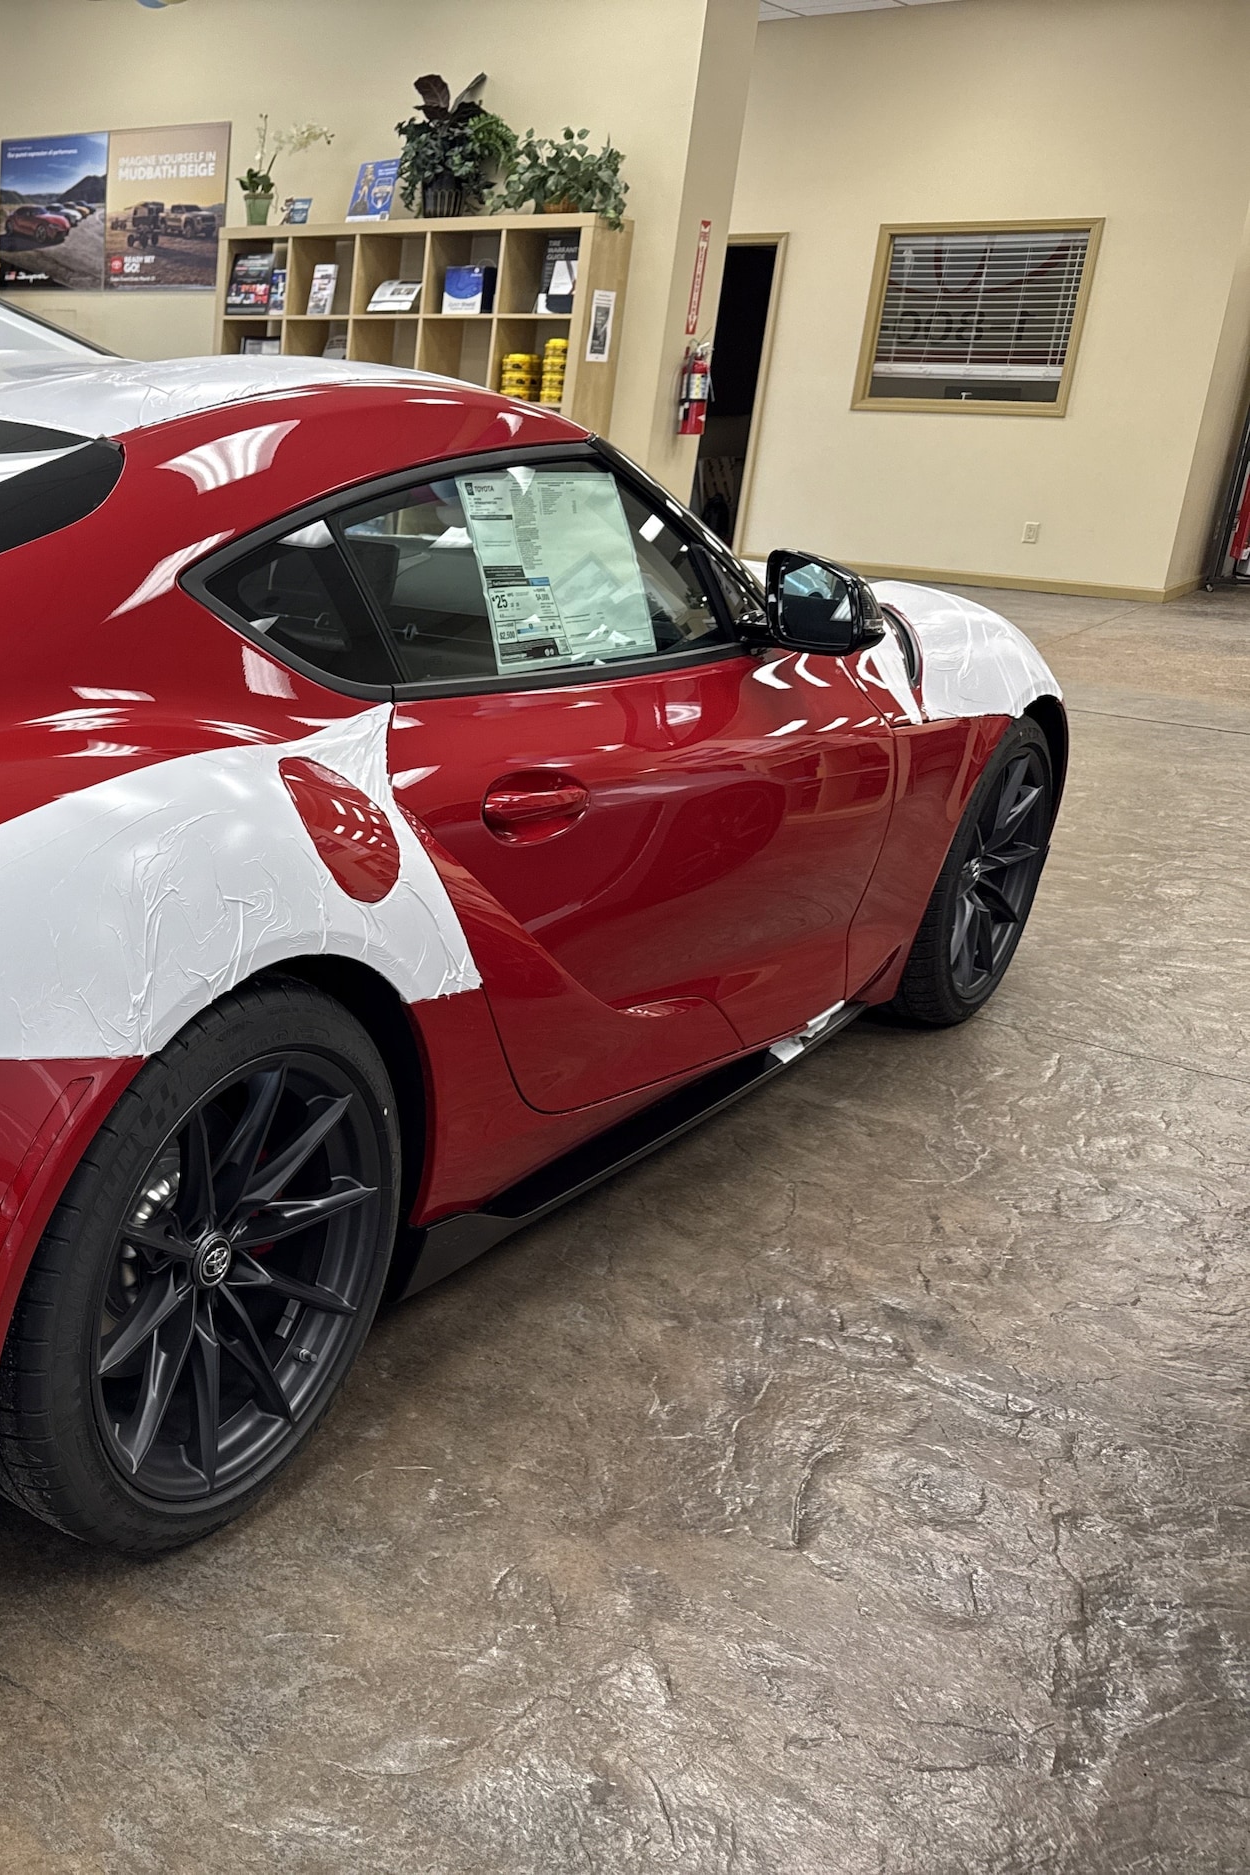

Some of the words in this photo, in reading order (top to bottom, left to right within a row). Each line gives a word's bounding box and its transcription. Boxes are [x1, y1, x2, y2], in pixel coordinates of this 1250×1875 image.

[118, 155, 157, 167] IMAGINE
[158, 152, 204, 165] YOURSELF
[205, 151, 216, 162] IN
[118, 165, 177, 182] MUDBATH
[179, 163, 215, 178] BEIGE
[474, 485, 494, 493] TOYOTA
[497, 594, 508, 609] 25
